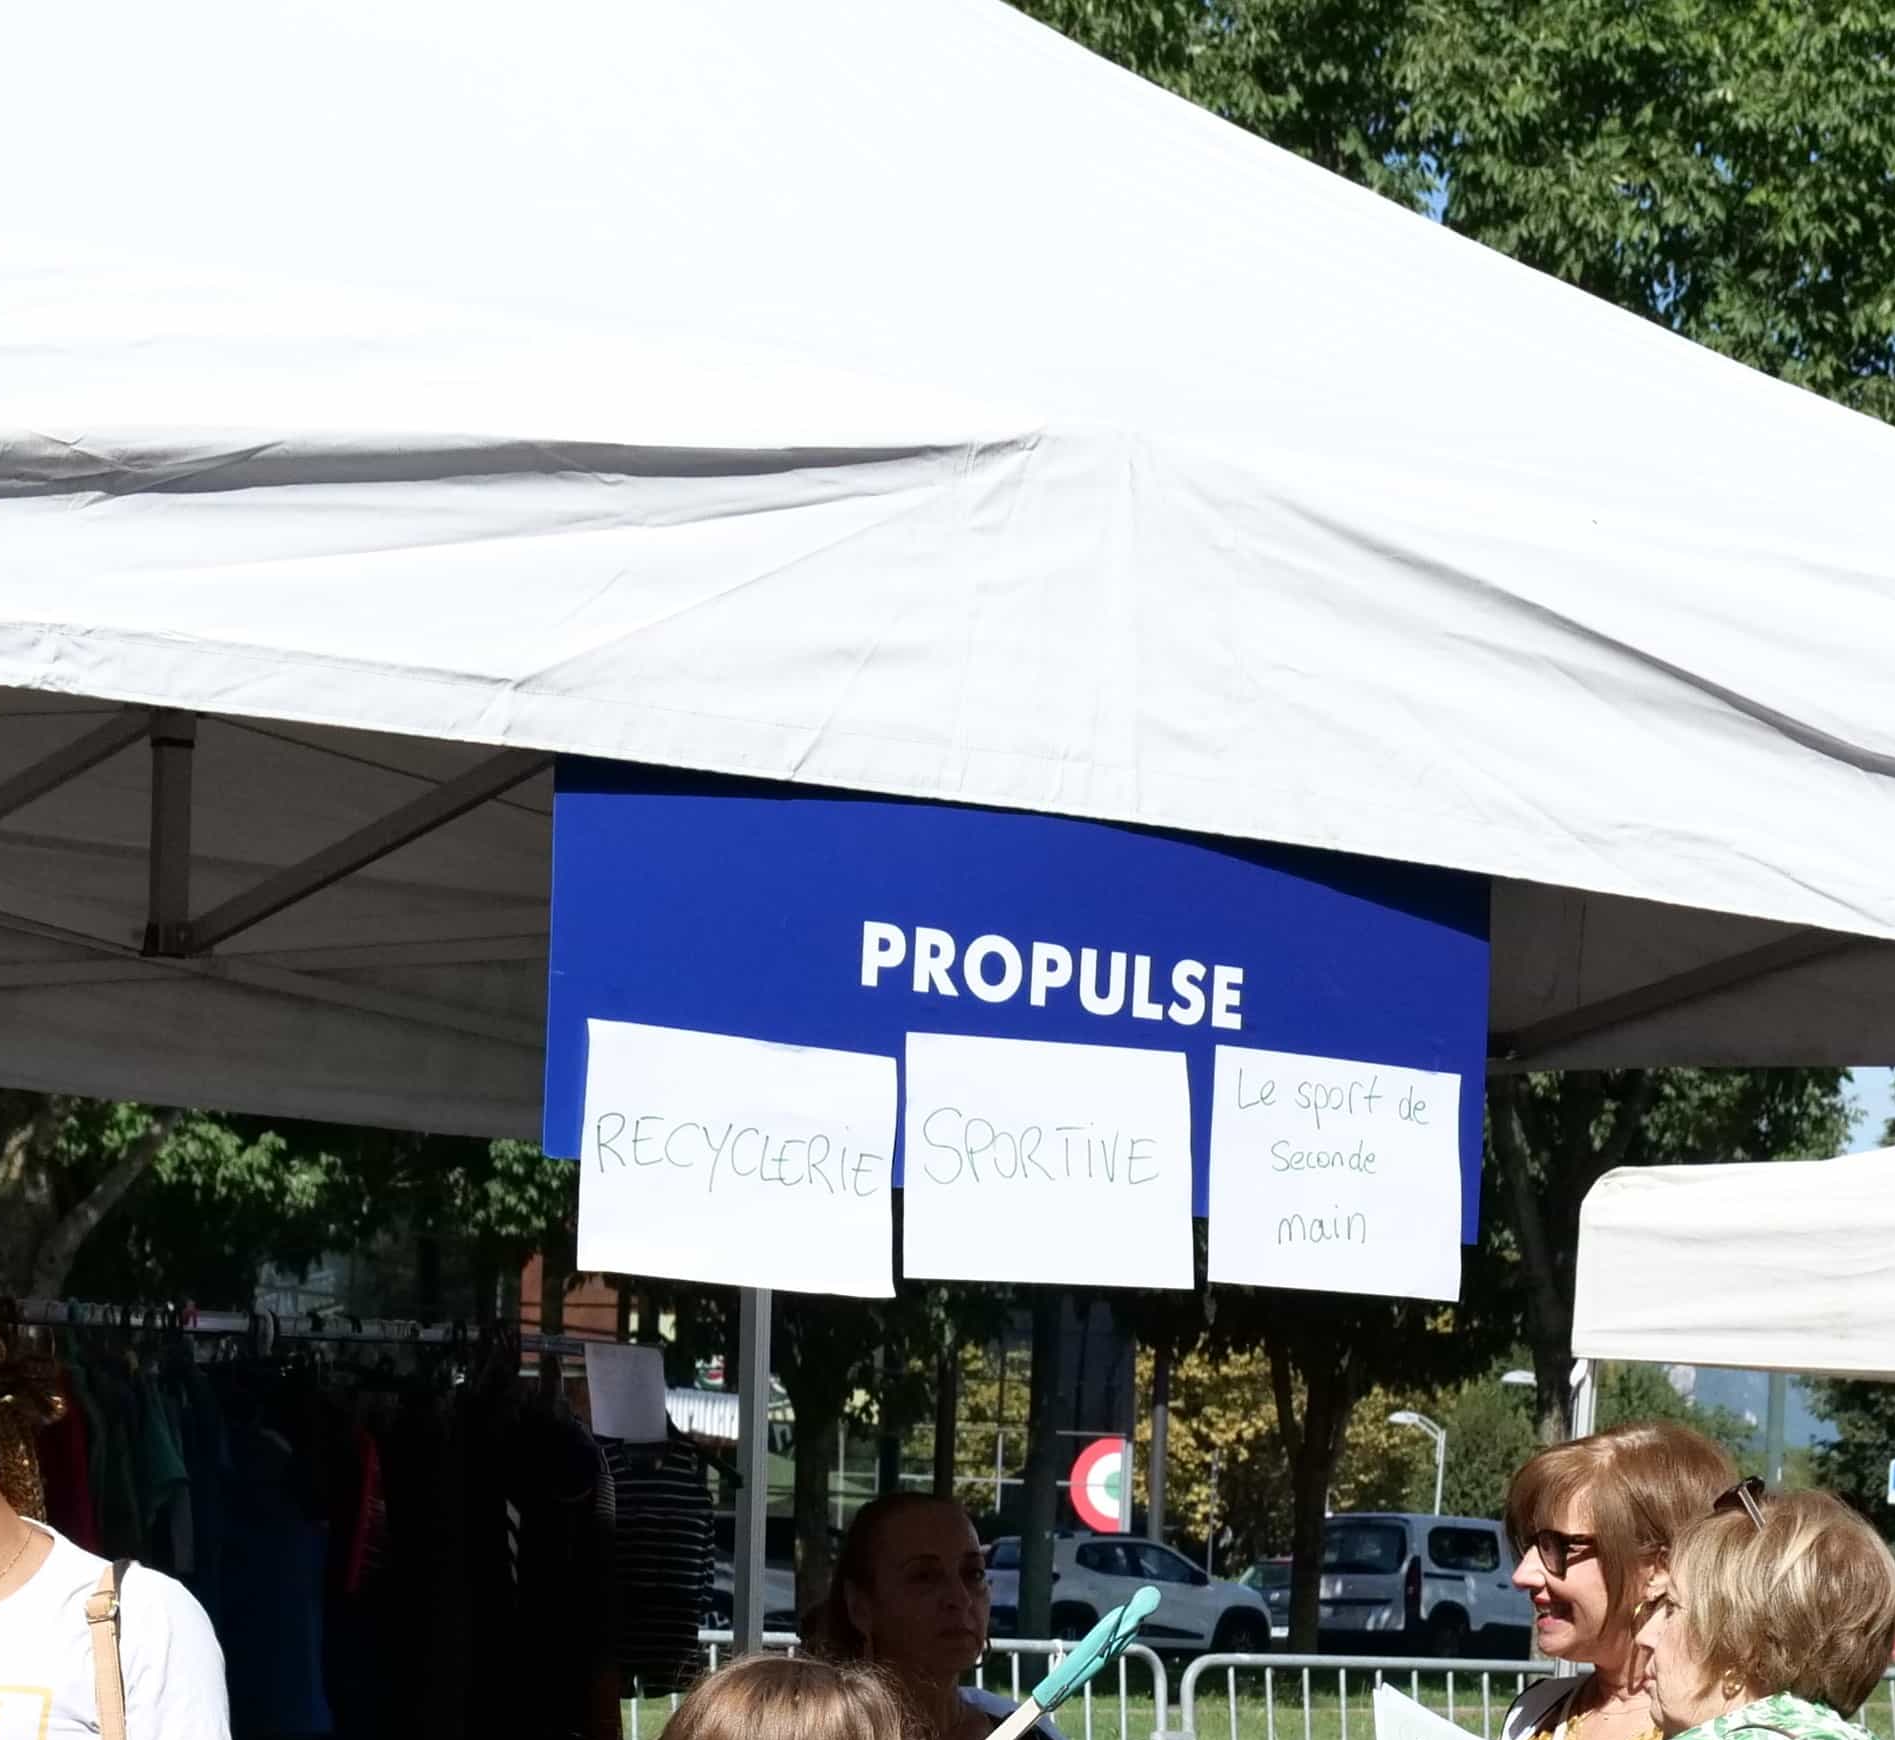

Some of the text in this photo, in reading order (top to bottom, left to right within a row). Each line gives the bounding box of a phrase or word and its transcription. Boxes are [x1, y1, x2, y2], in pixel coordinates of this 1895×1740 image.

[860, 920, 1245, 1030] PROPULSE
[1237, 1067, 1429, 1126] Le sport de
[1278, 1210, 1367, 1247] main
